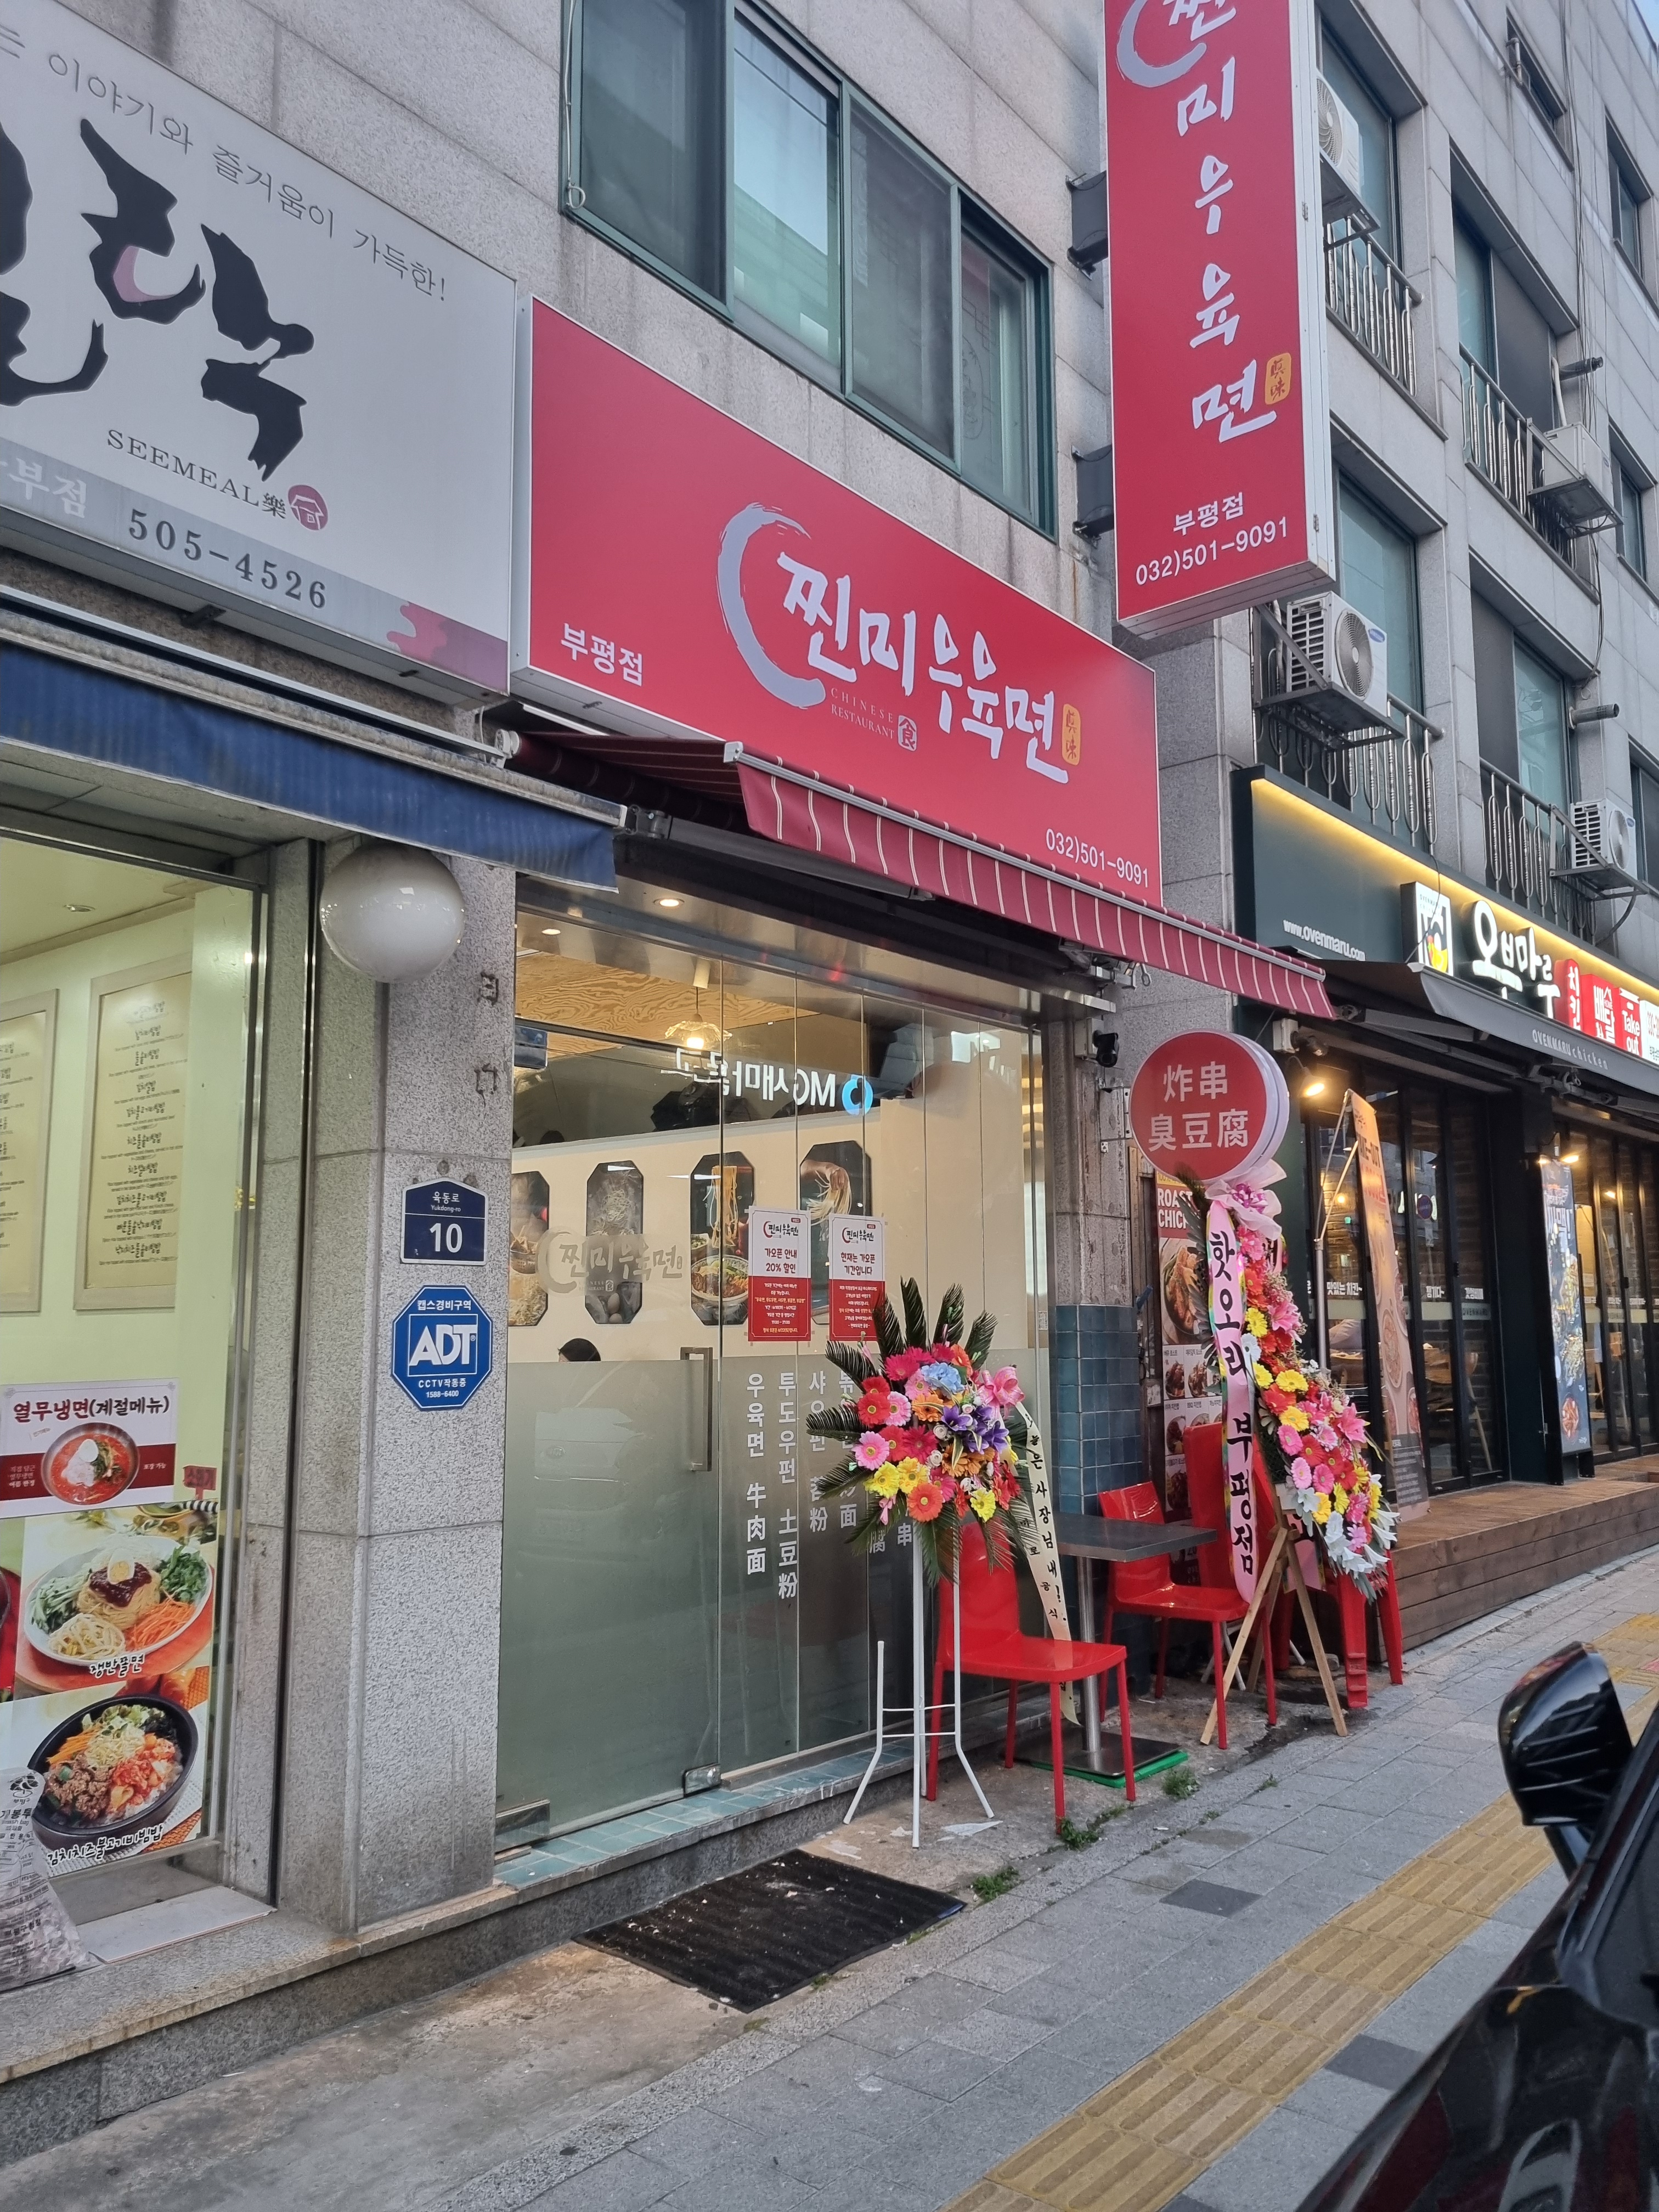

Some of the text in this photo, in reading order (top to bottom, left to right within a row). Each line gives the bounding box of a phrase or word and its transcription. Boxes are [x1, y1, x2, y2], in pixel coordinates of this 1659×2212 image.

[48, 53, 194, 155] 이야기와
[213, 145, 334, 238] 즐거움이
[353, 229, 446, 302] 가득한!
[1172, 492, 1245, 538] 부평점
[128, 509, 326, 608] 505-4526
[1135, 516, 1288, 587] 032)501-9091
[560, 623, 644, 687] 부평점
[777, 552, 1069, 784] 찐미우육면
[831, 687, 894, 723] CHINESE
[831, 704, 895, 740] RESTAURANT
[1045, 827, 1149, 888] 032)501-9091
[1622, 1009, 1640, 1037] Take
[1532, 1029, 1609, 1070] OVENMARU chicken
[1627, 1035, 1640, 1056] out
[1163, 1061, 1228, 1102] 炸串
[1148, 1108, 1249, 1152] 臭豆腐
[431, 1204, 461, 1214] Yukdong-ro
[432, 1190, 460, 1204] 육동로
[429, 1222, 463, 1254] 10
[764, 1248, 798, 1259] 가오픈 안내
[766, 1262, 796, 1273] 20% 할인
[840, 1252, 876, 1264] 현재는 가오픈
[844, 1265, 873, 1276] 기간입니다
[416, 1299, 472, 1311] 캡스경비구역
[409, 1324, 477, 1366] ADT
[418, 1378, 467, 1389] CCTV작동중
[425, 1390, 460, 1399] 1588-6400
[13, 1395, 170, 1423] 열무냉면(계절메뉴)
[746, 1373, 766, 1575] 우육면 牛肉面
[778, 1372, 798, 1600] 투도우펀 土豆粉
[1226, 1412, 1253, 1575] 부평점
[90, 1653, 145, 1677] 쟁반쫄면
